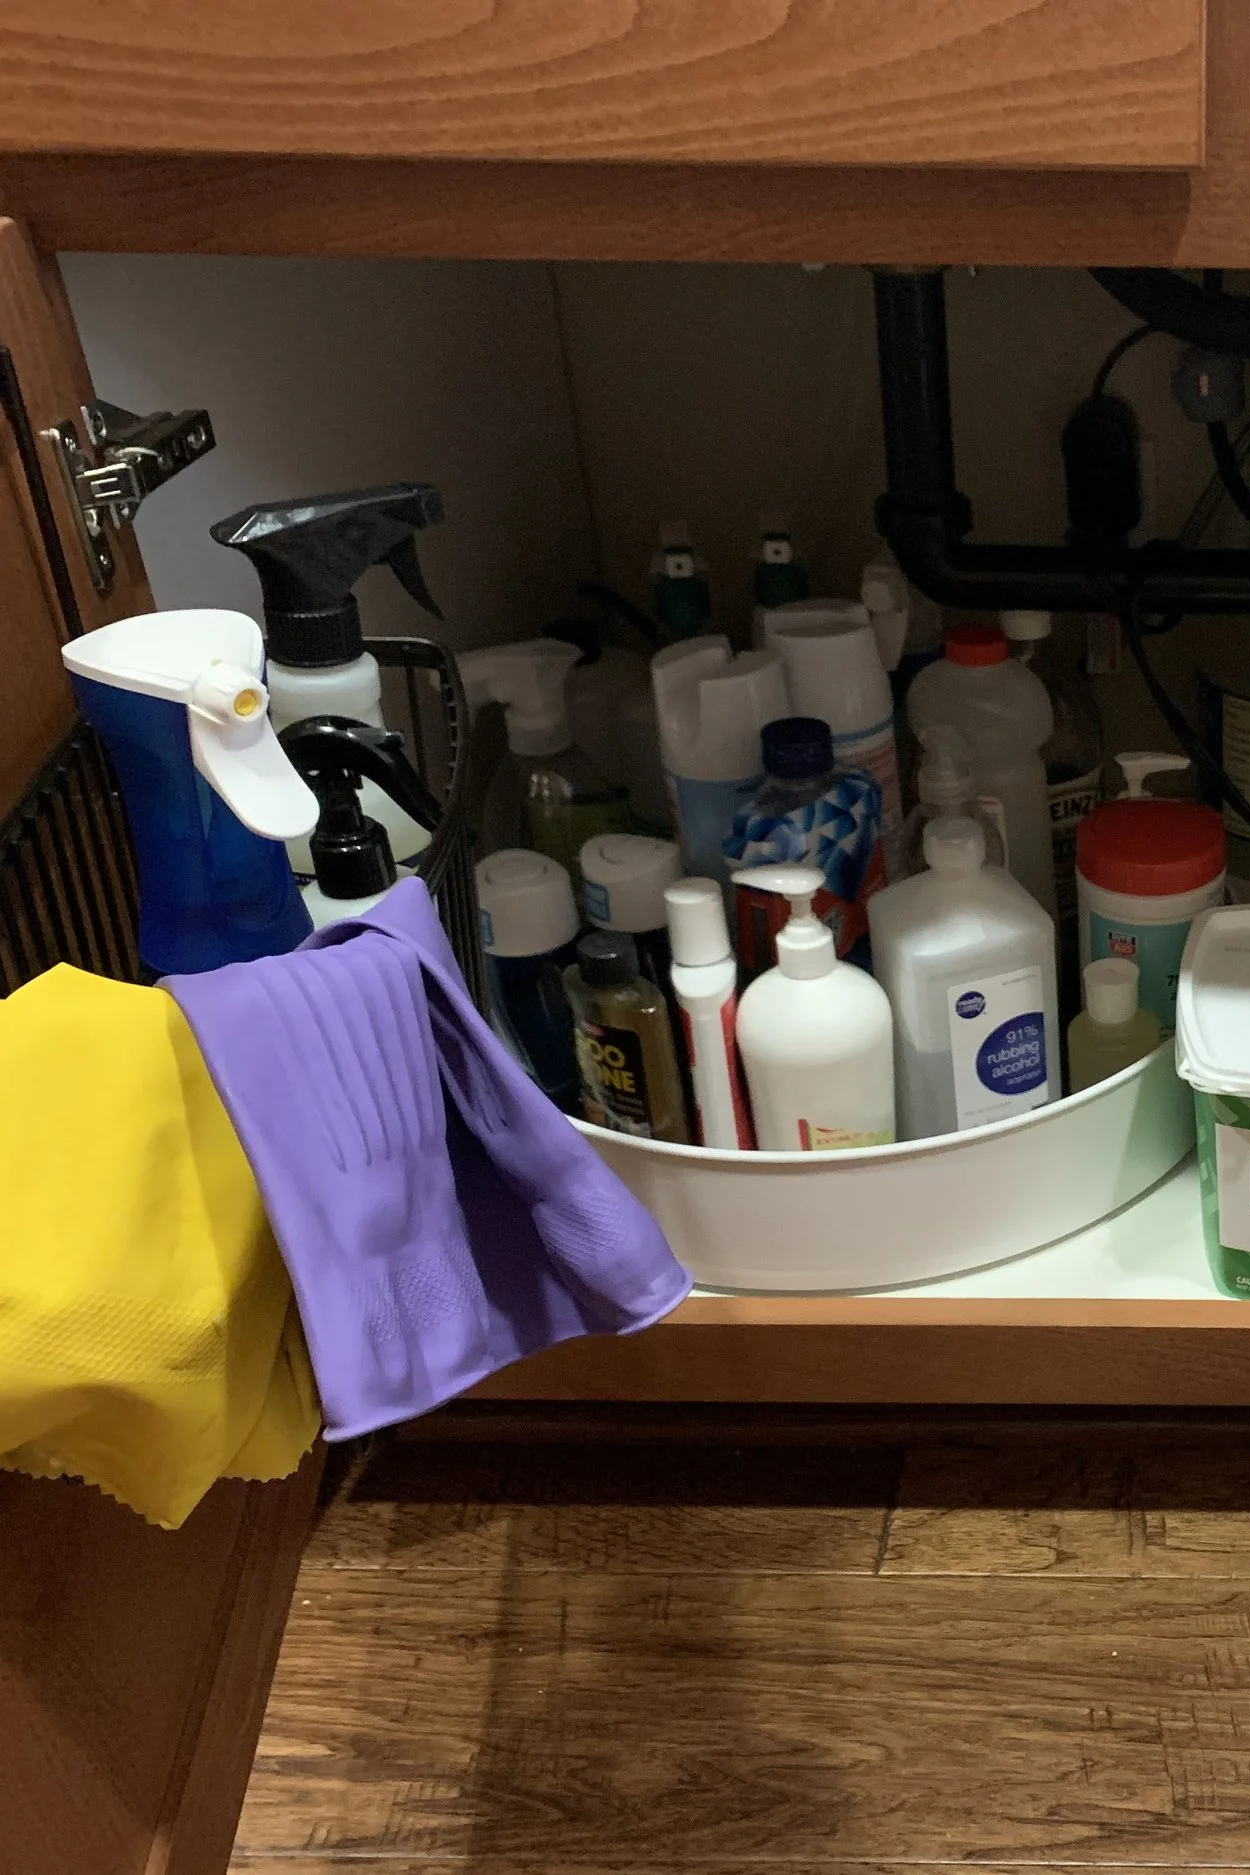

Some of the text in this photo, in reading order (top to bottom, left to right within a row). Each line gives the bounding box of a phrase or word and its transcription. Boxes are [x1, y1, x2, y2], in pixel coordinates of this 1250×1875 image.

[1049, 795, 1092, 821] EINZ
[1005, 1025, 1038, 1043] 91%
[987, 1041, 1040, 1065] rubbing
[992, 1054, 1041, 1078] alcohol
